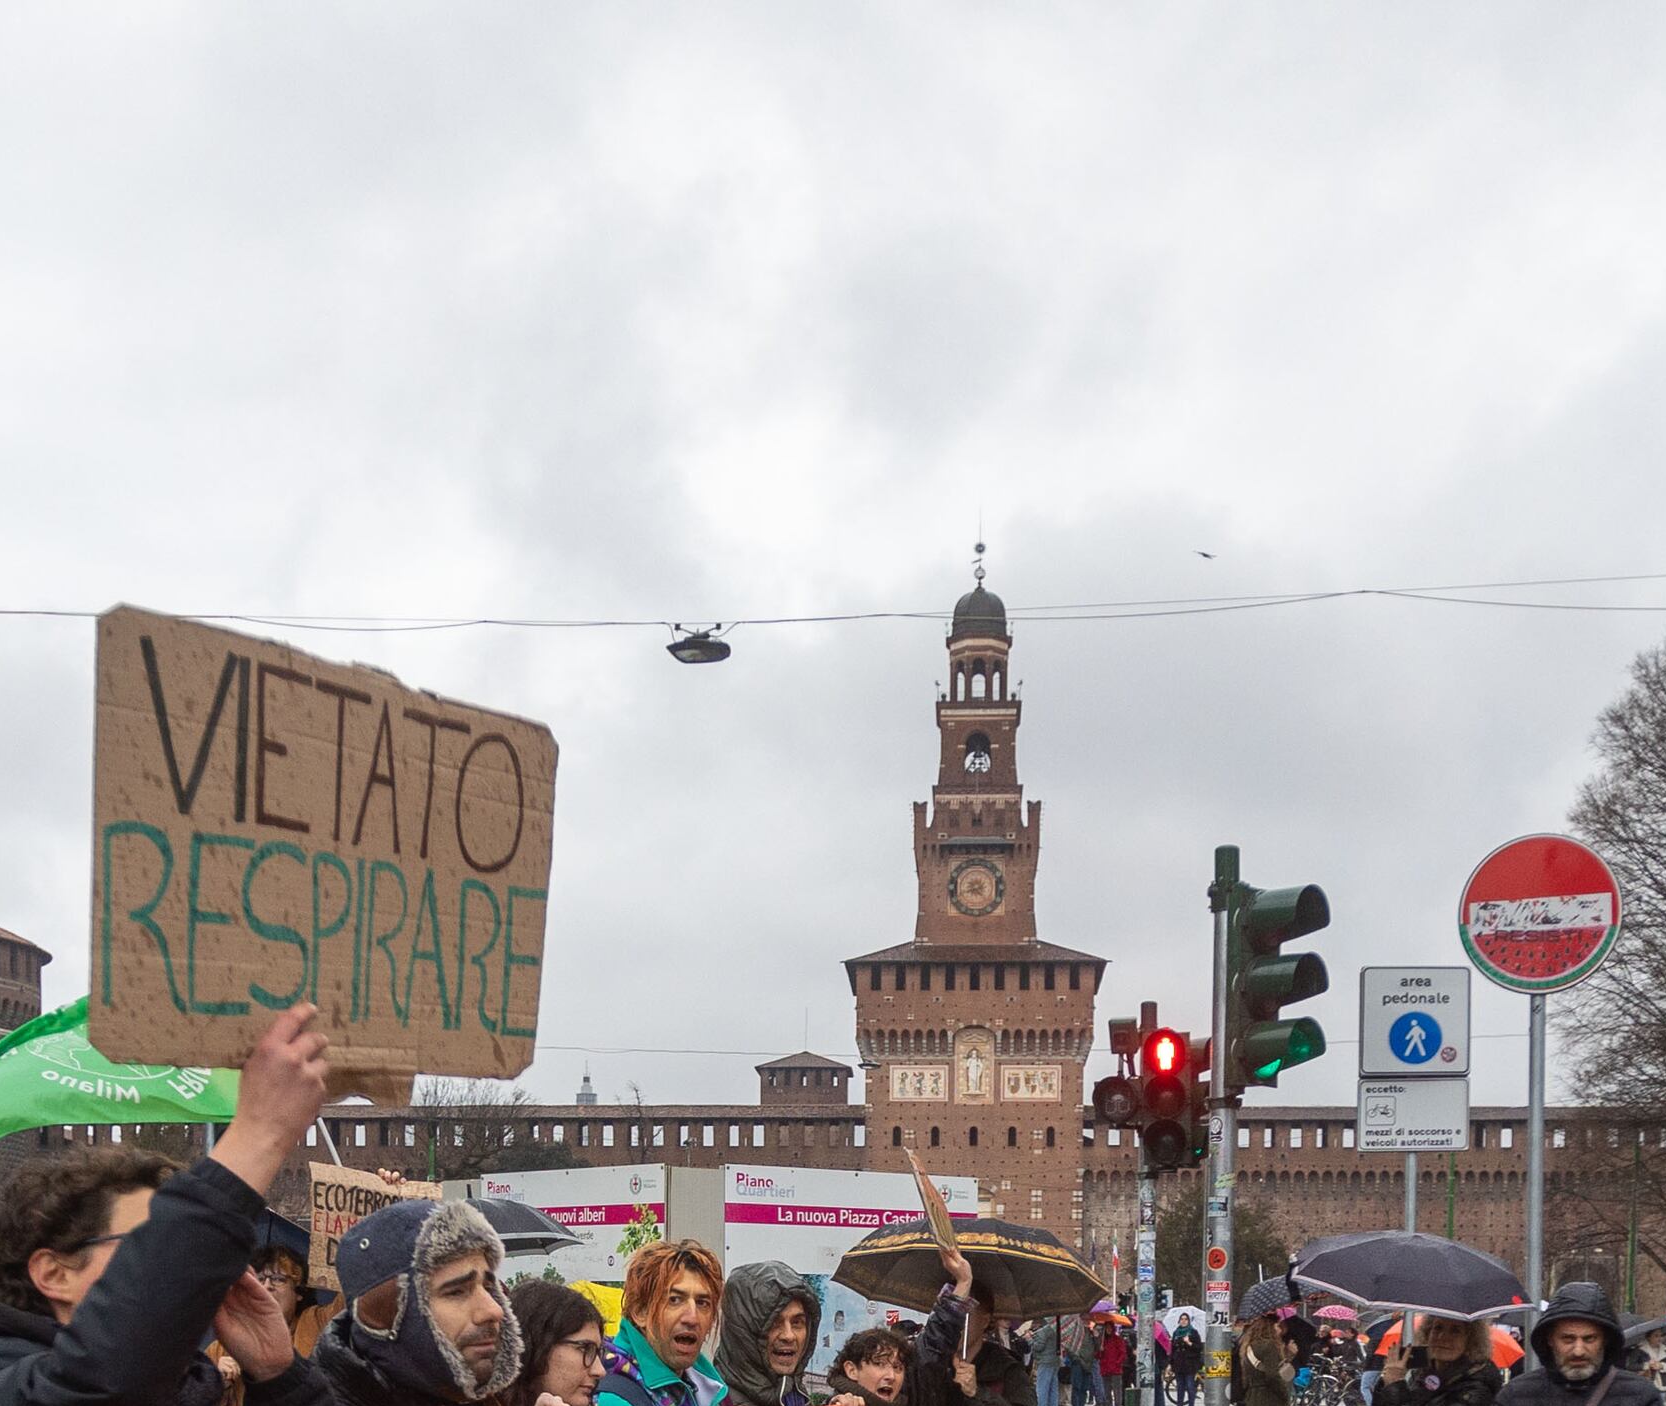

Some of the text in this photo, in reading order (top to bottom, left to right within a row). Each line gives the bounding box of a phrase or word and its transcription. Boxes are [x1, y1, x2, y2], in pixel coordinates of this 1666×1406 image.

[139, 635, 525, 874] VIETATO
[102, 819, 548, 1038] RESPIRARE
[1400, 977, 1432, 986] area
[1382, 992, 1450, 1005] pedonale
[1365, 1128, 1392, 1136] mezzi
[1395, 1127, 1405, 1136] di
[1408, 1128, 1452, 1136] soccorso
[1365, 1137, 1453, 1147] veicoli autorizzati
[487, 1180, 511, 1194] Piano
[736, 1172, 774, 1188] Piano
[736, 1183, 795, 1198] Quartieri
[578, 1206, 605, 1223] alberi
[777, 1207, 793, 1222] La
[797, 1211, 836, 1224] nuova
[840, 1209, 880, 1225] Piazza
